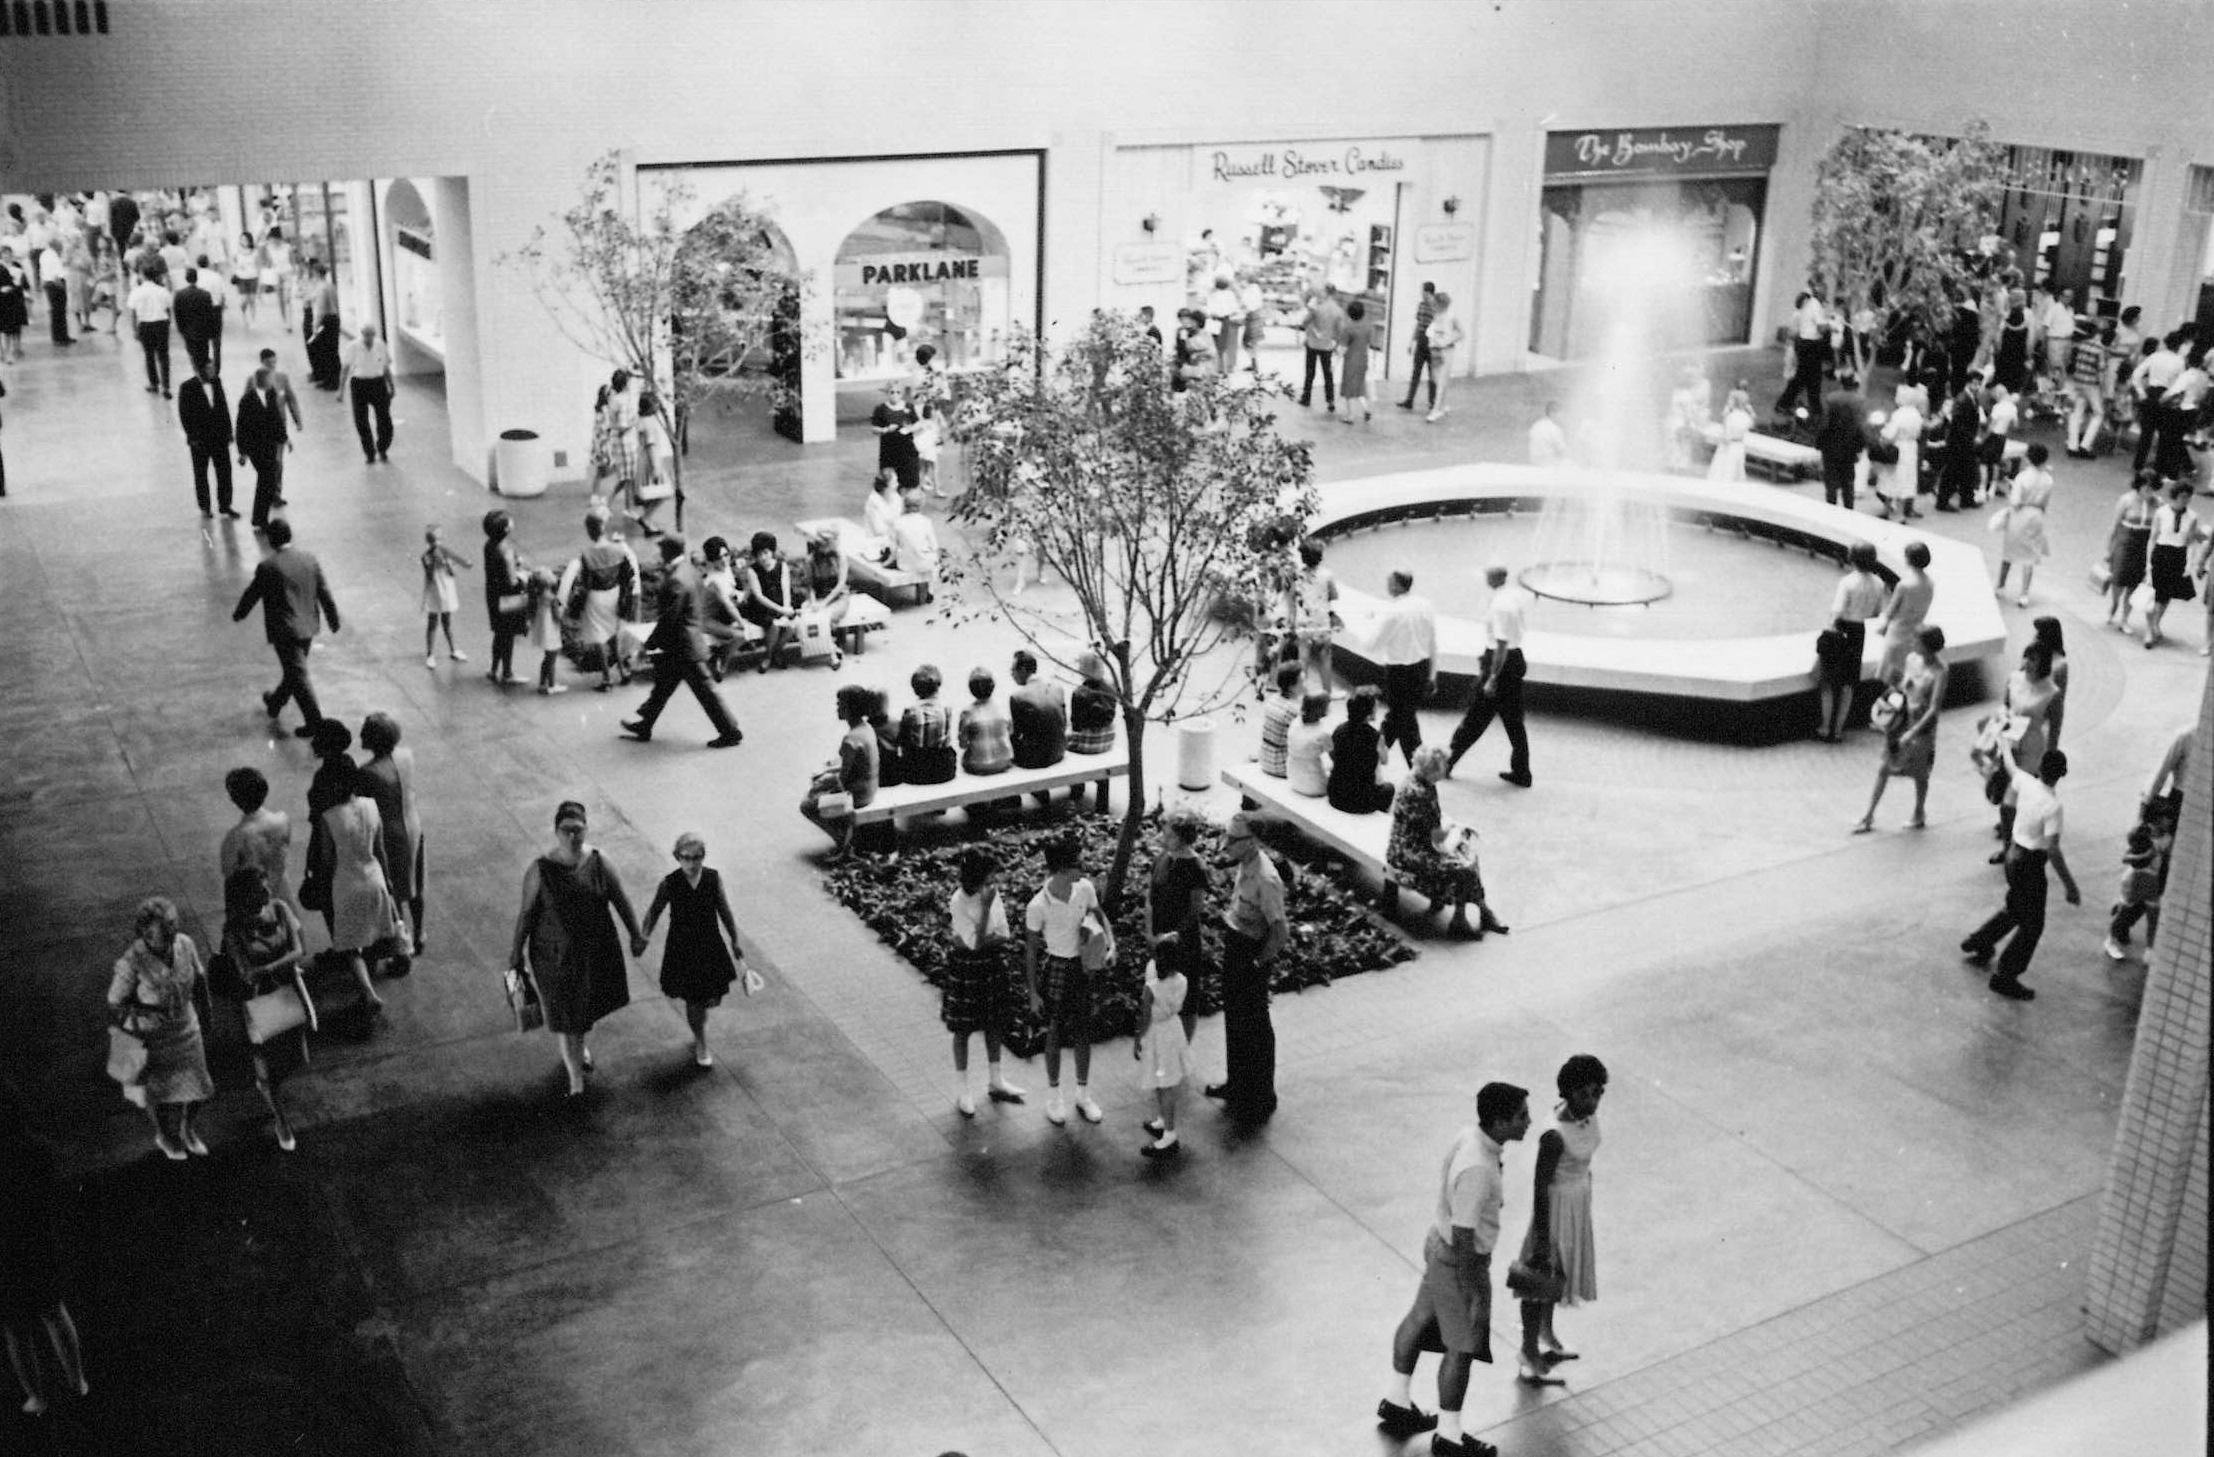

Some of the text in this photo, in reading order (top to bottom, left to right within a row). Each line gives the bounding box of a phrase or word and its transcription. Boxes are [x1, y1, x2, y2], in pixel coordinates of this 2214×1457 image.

[1212, 147, 1404, 182] Russell Stover Candies
[1574, 130, 1747, 166] The Bombay Shop
[862, 260, 979, 285] PARKLANE
